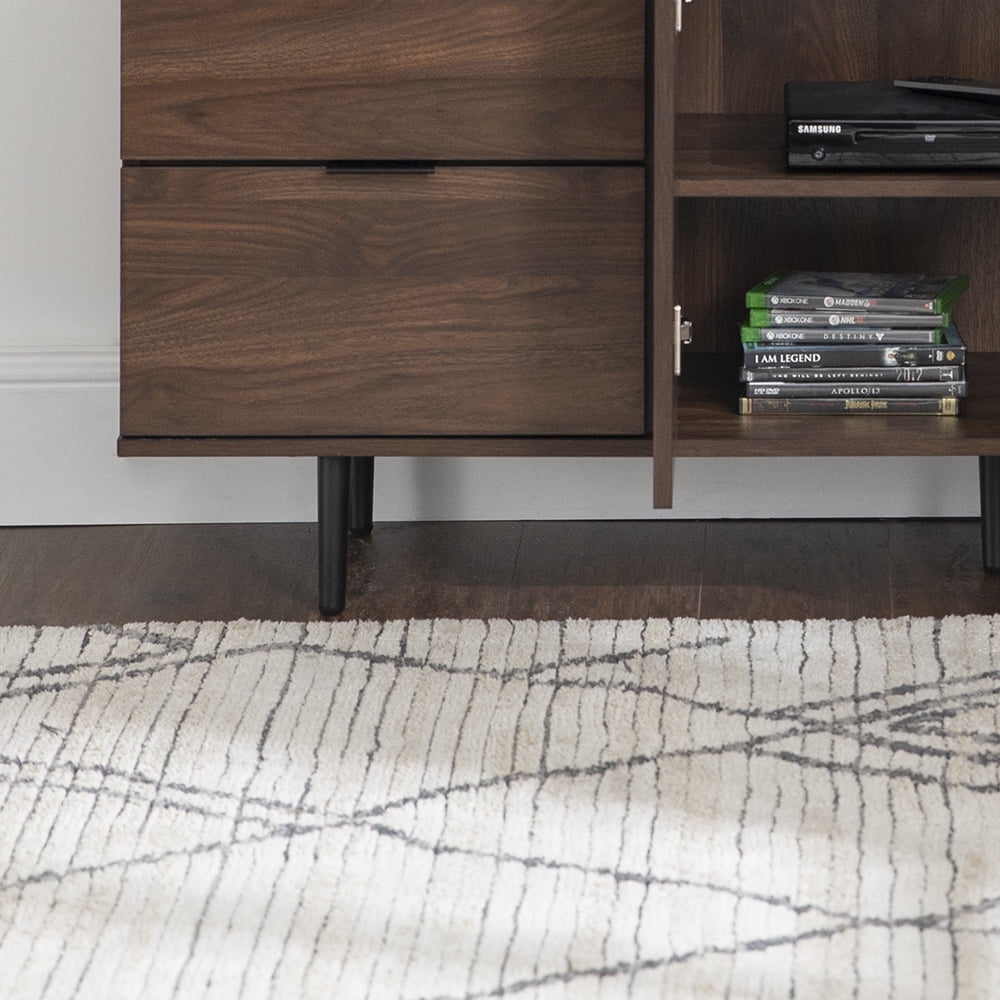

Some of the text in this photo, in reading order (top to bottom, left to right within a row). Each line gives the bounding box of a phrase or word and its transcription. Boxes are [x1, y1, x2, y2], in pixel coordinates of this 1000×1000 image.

[798, 125, 842, 134] SAMSUNG
[835, 299, 864, 307] MADDEN
[840, 316, 856, 325] NHL
[761, 354, 777, 363] AM
[780, 353, 821, 363] LEGEND
[896, 367, 923, 382] 2012
[831, 387, 881, 395] APOLLO 13
